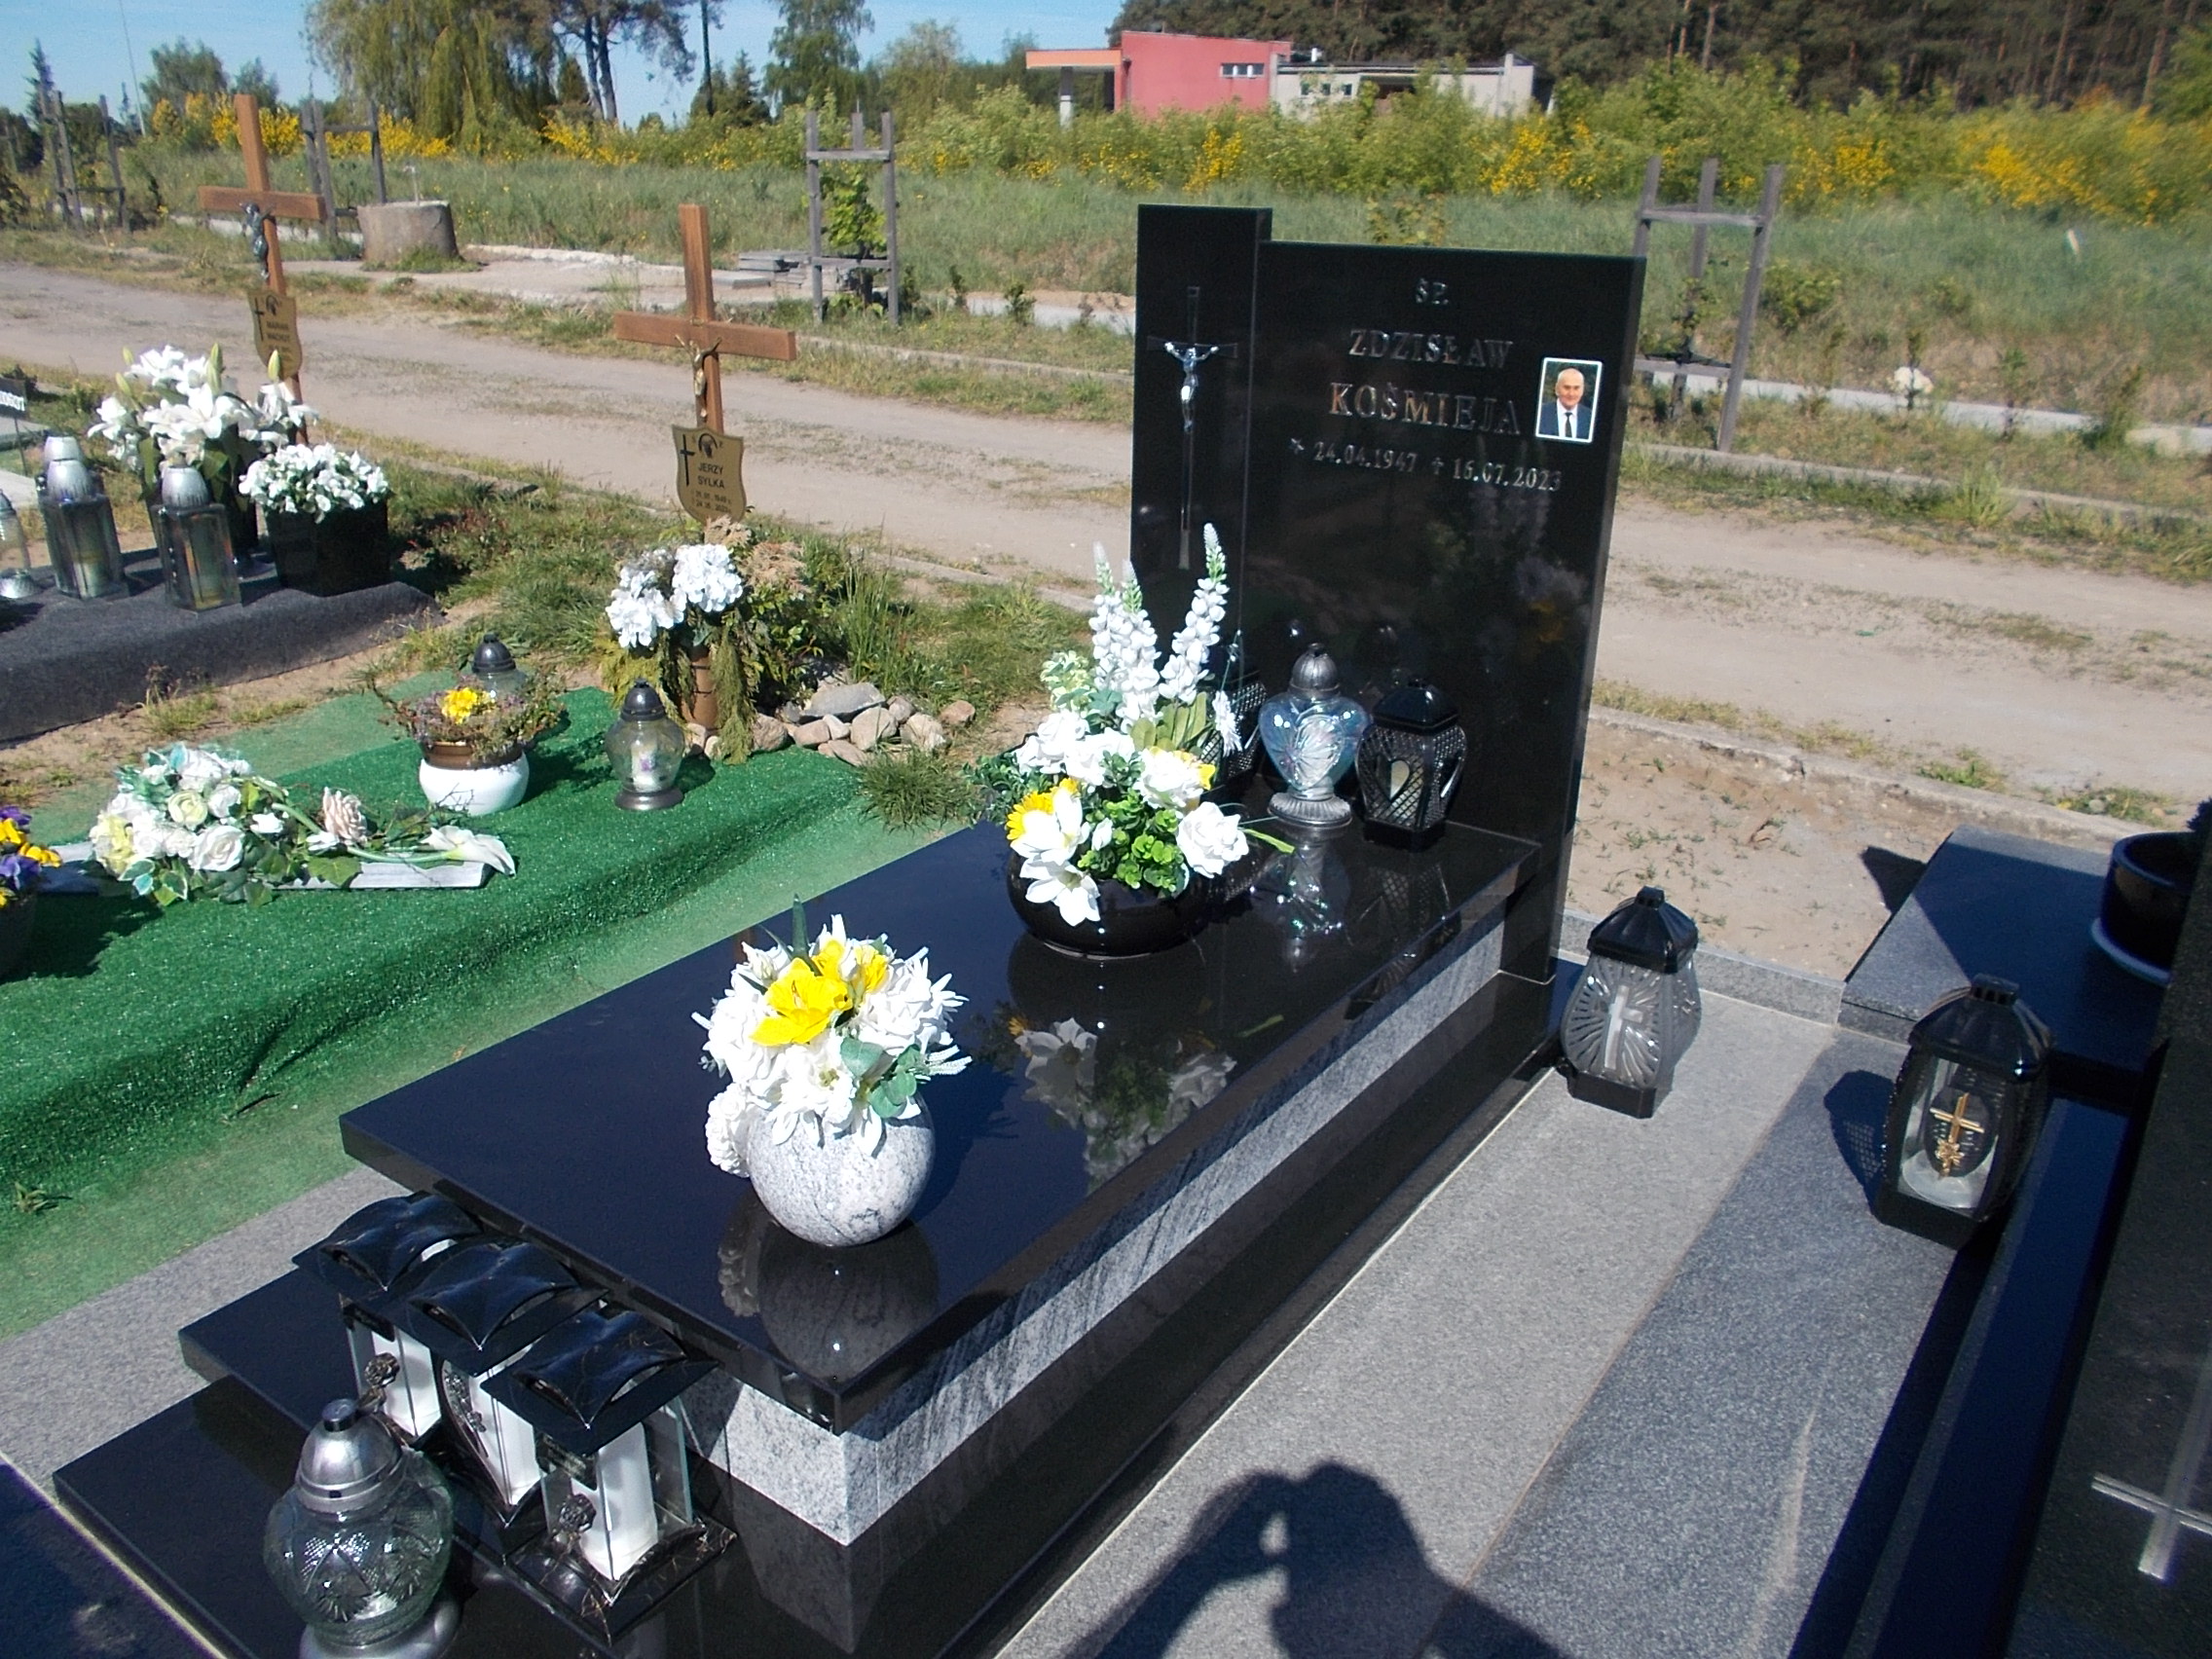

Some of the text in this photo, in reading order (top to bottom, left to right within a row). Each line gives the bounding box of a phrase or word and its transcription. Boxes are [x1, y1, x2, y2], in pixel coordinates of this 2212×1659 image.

[1348, 329, 1514, 368] ZDZISŁAW
[1329, 382, 1521, 435] KOŚMIEJA
[698, 462, 724, 475] JERZY
